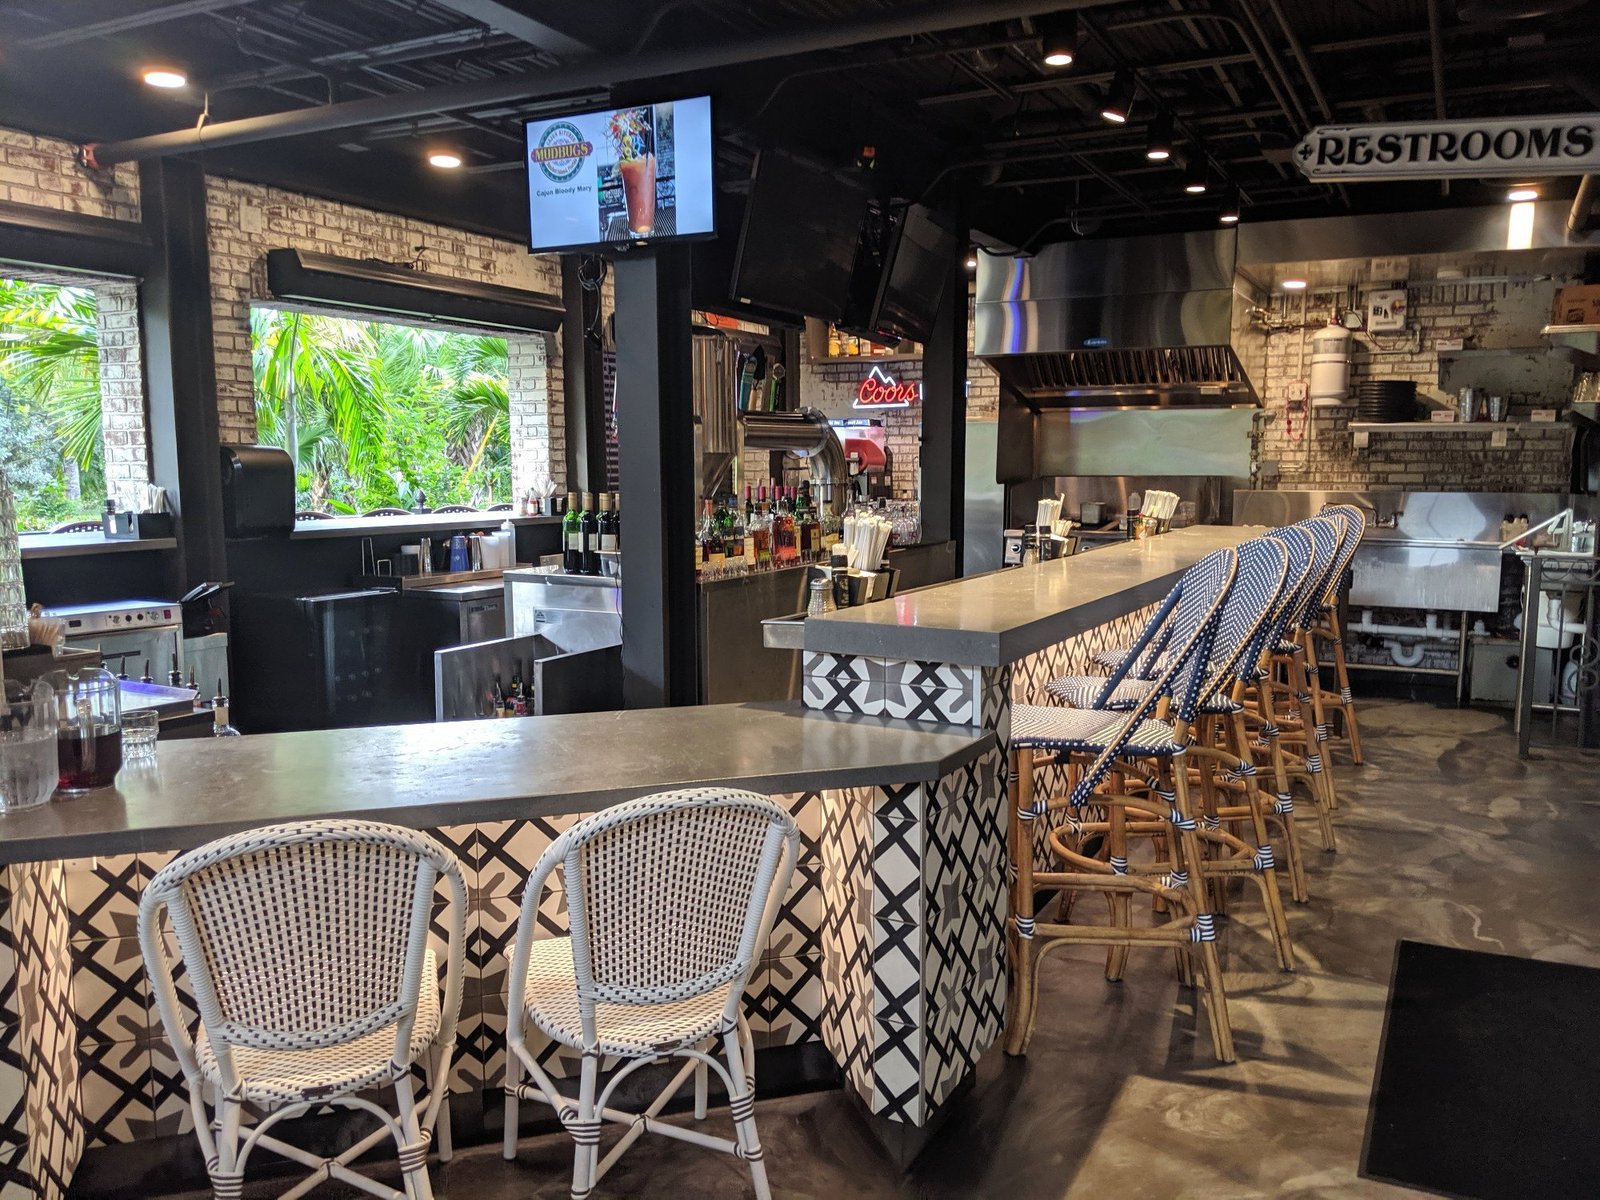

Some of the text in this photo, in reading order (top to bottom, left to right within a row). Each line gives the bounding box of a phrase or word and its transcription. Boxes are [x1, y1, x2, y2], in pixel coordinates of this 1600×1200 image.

[535, 144, 588, 161] MUDBUGS
[1316, 125, 1595, 166] RESTROOMS
[859, 378, 918, 403] Coors
